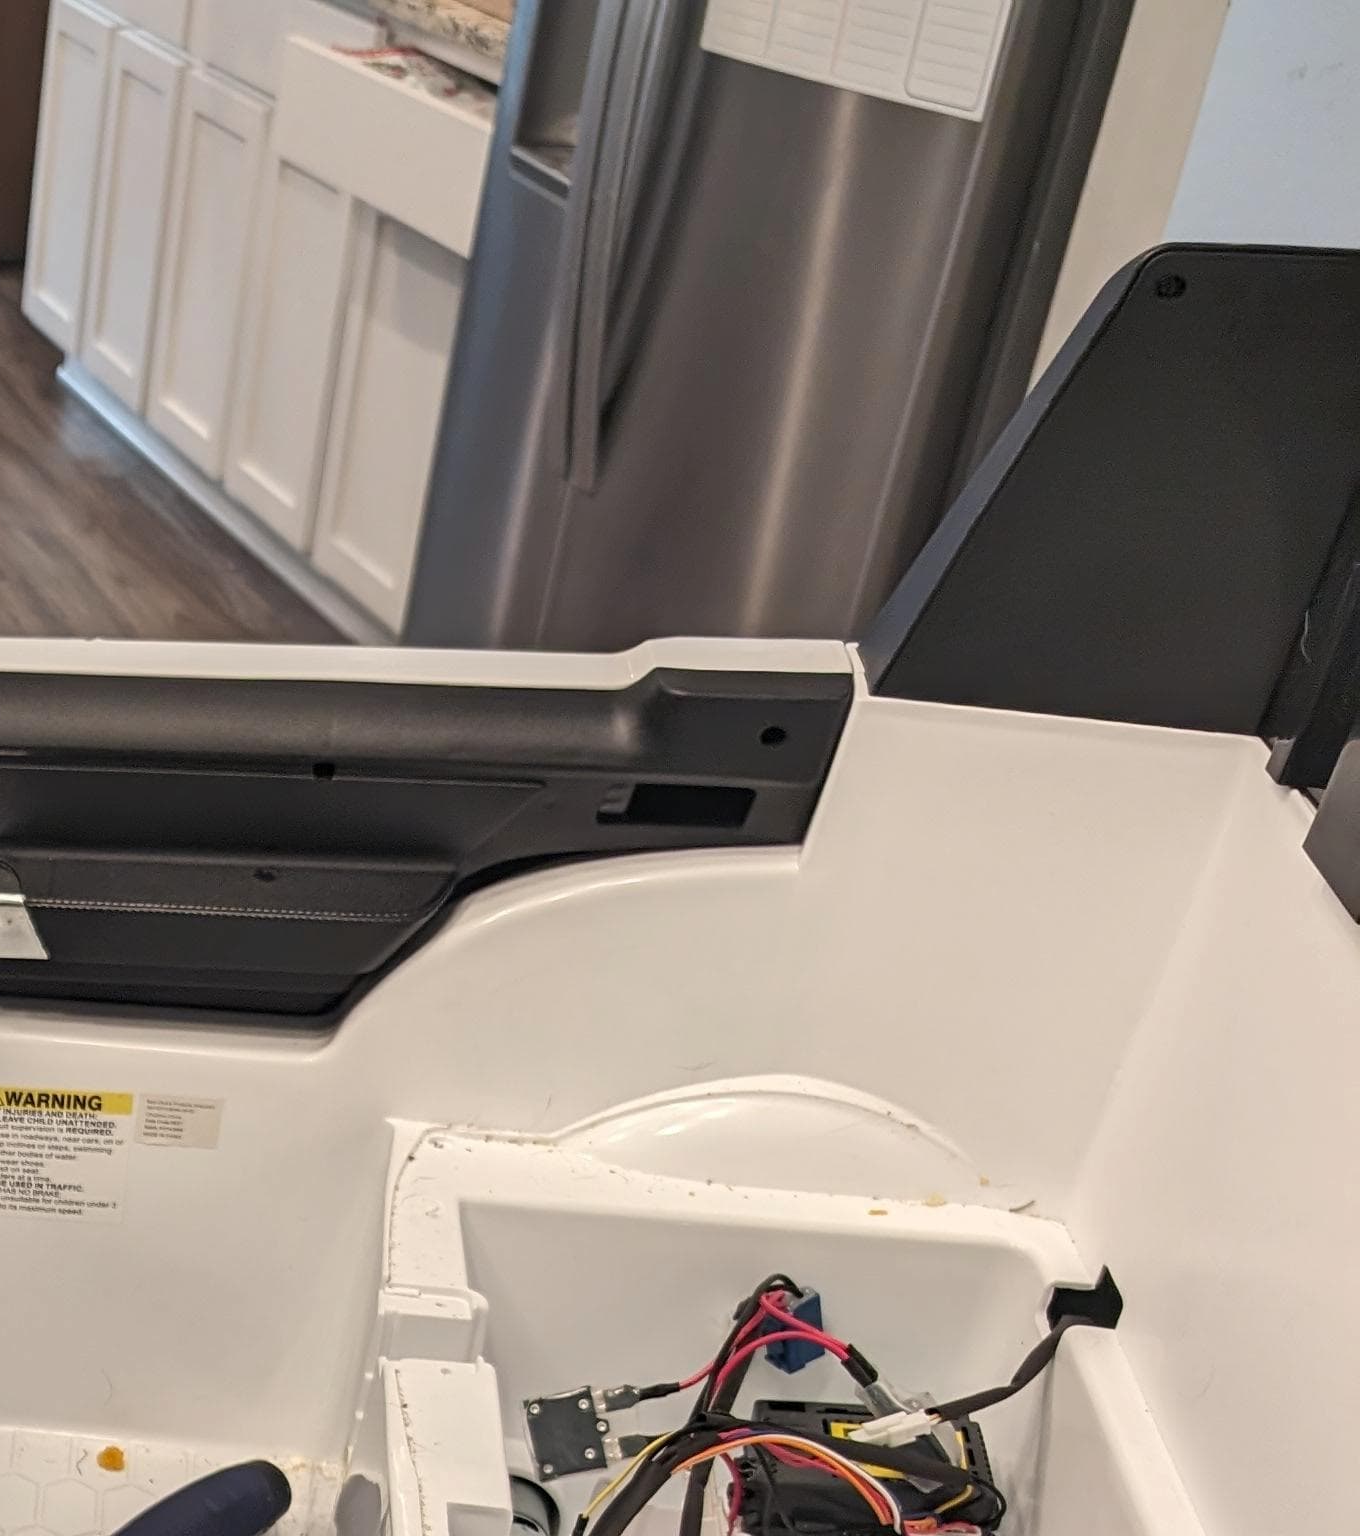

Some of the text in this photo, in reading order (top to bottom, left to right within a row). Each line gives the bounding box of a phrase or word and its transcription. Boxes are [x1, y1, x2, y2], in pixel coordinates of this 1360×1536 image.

[4, 1091, 102, 1111] WARNING
[2, 1108, 43, 1117] INJURIES
[27, 1117, 54, 1125] CHILD
